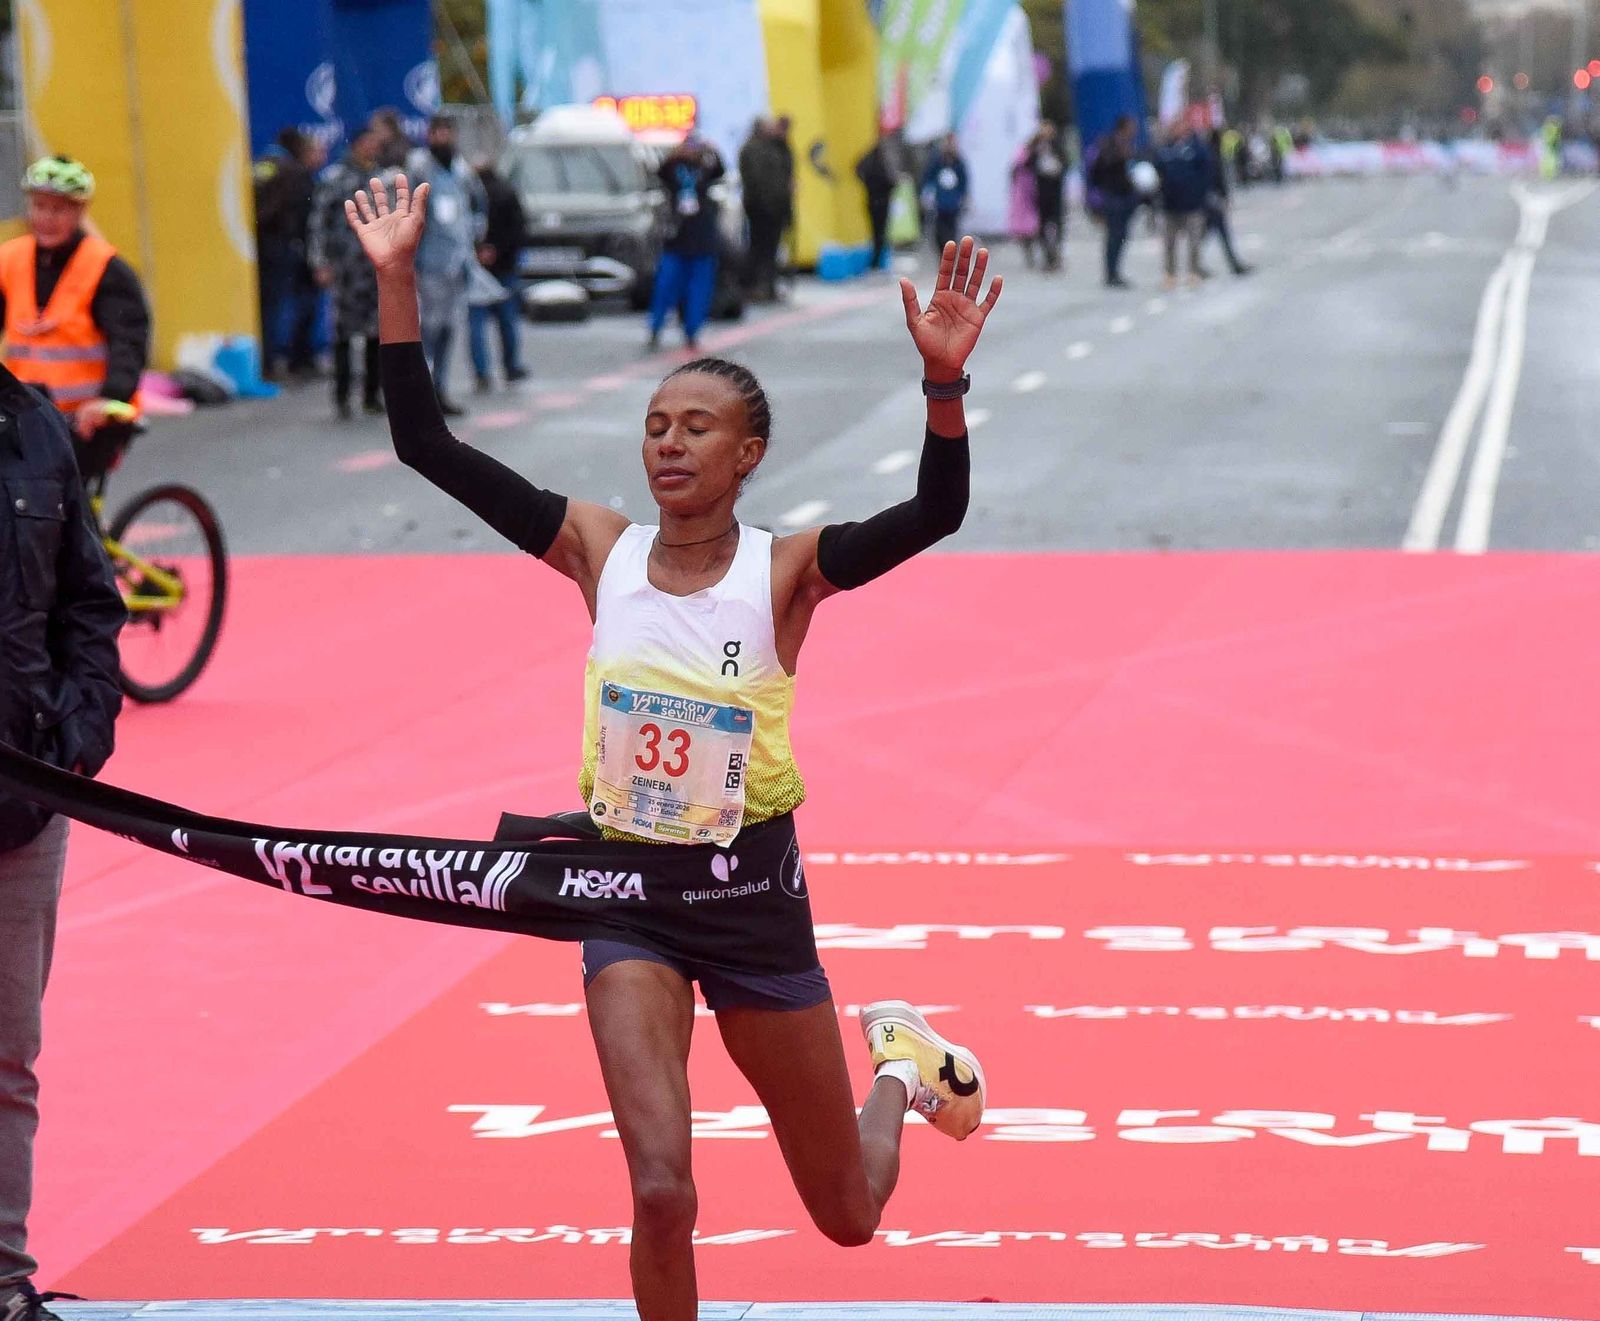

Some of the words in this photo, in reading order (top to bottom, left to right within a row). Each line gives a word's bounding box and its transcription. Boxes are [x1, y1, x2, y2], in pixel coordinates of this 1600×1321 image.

[660, 705, 705, 723] sevilla
[634, 722, 692, 778] 33
[631, 775, 672, 793] ZEINEBA
[656, 801, 675, 809] enero
[631, 817, 653, 829] HOKA
[558, 868, 647, 901] HOKA
